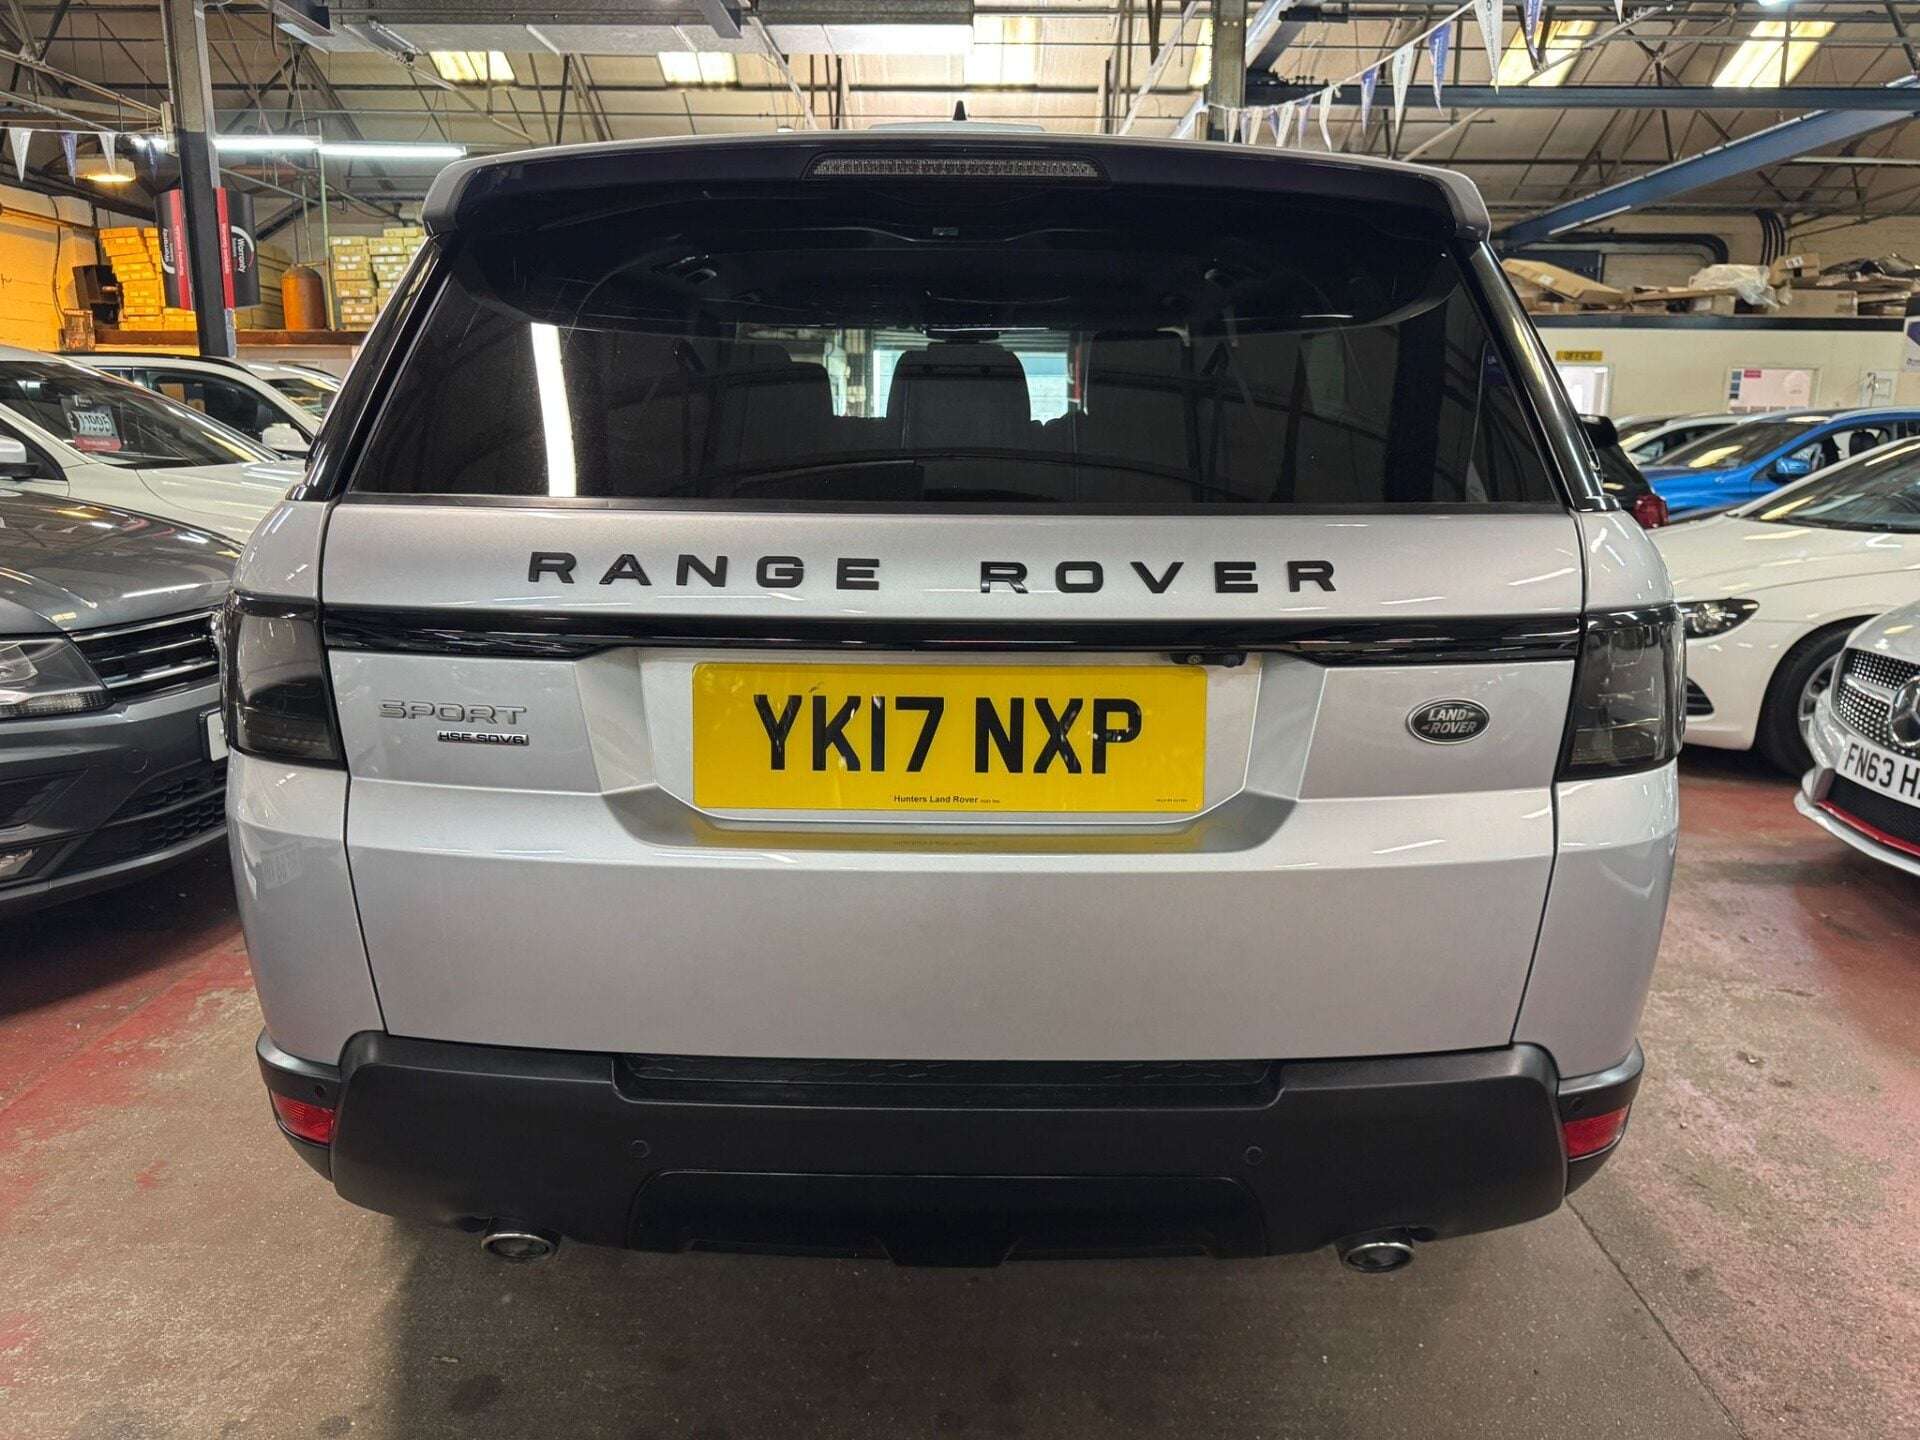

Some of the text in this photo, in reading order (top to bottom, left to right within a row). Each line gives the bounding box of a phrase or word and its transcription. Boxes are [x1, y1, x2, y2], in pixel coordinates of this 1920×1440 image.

[237, 238, 247, 272] Warranty
[528, 551, 1337, 595] RANGE ROVER
[379, 700, 527, 725] SPORT
[1428, 708, 1468, 721] LAND
[439, 731, 524, 745] HSE SDV6
[753, 694, 1143, 775] YK17 NXP
[1429, 721, 1477, 734] ROVER
[1843, 742, 1920, 800] FN63 H
[893, 794, 928, 804] Hunters
[929, 795, 951, 804] Land
[952, 795, 979, 805] Rover
